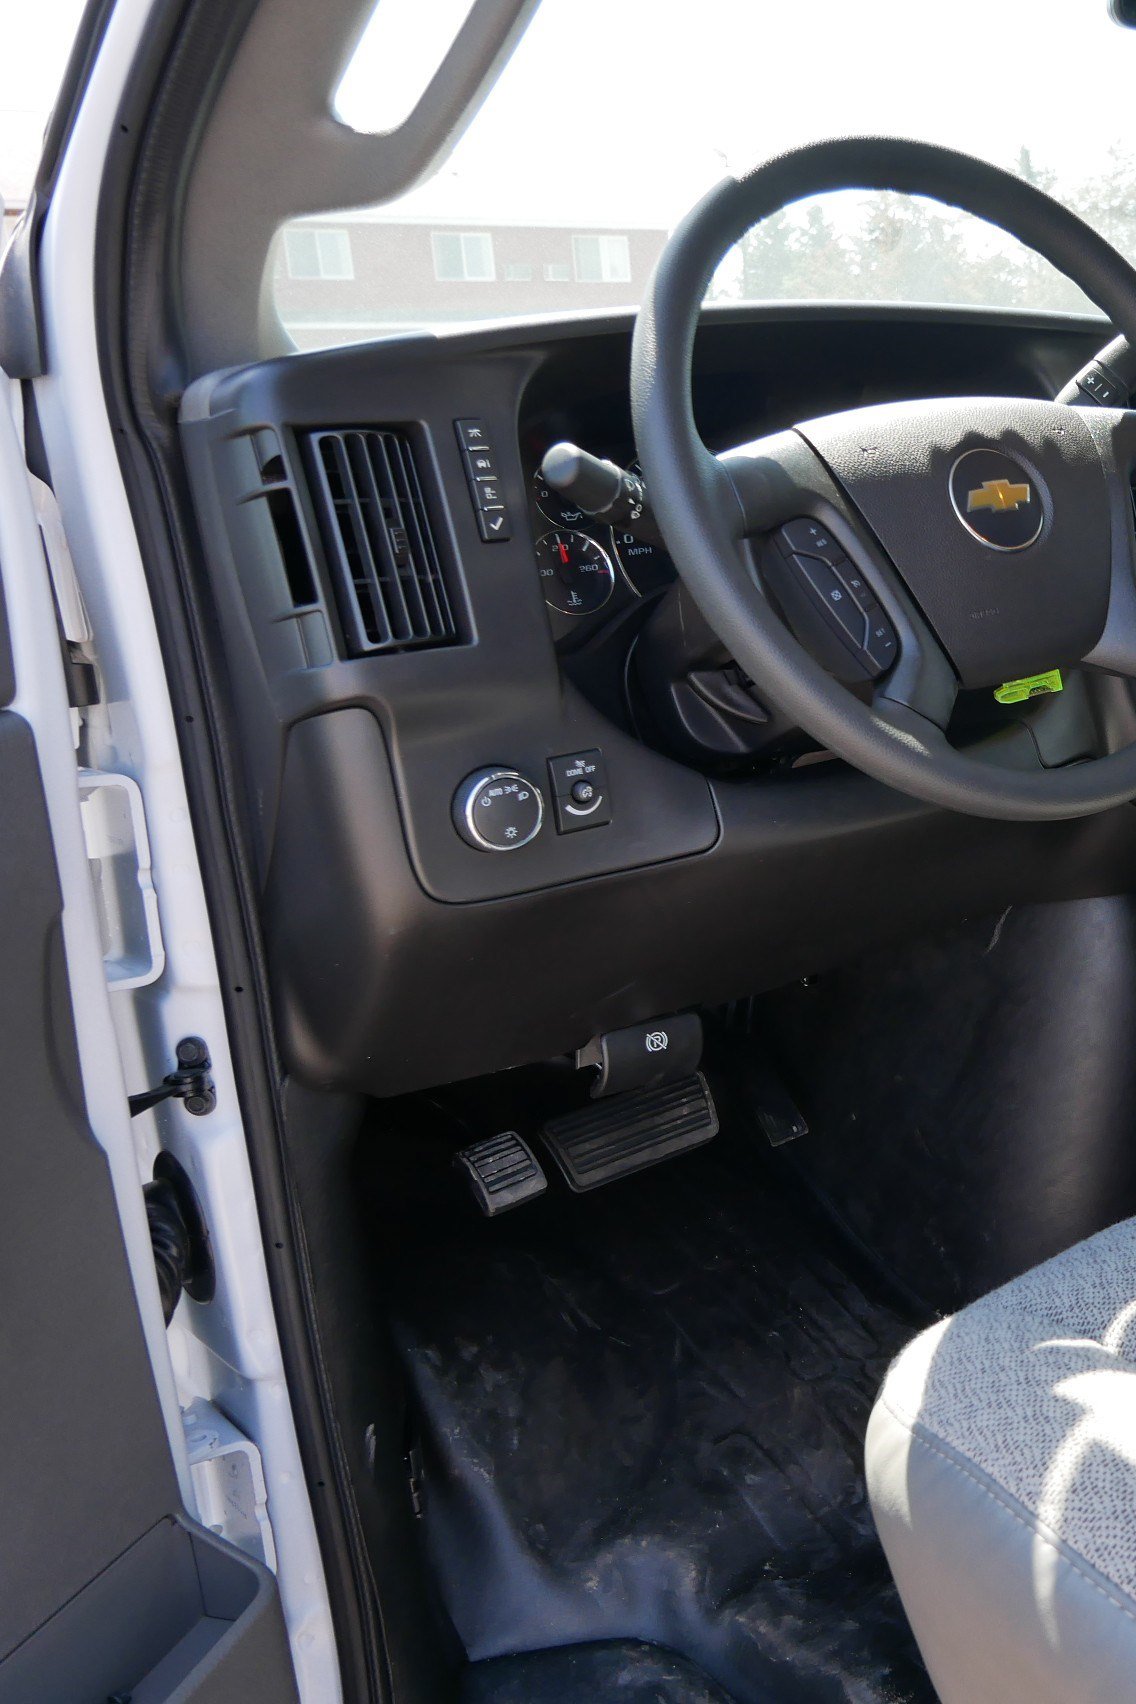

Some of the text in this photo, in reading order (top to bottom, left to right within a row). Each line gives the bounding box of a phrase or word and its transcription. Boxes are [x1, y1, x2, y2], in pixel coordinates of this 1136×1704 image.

[624, 533, 634, 544] 0
[628, 546, 653, 557] MPH
[579, 563, 599, 573] 260
[566, 765, 596, 777] DOME OFF
